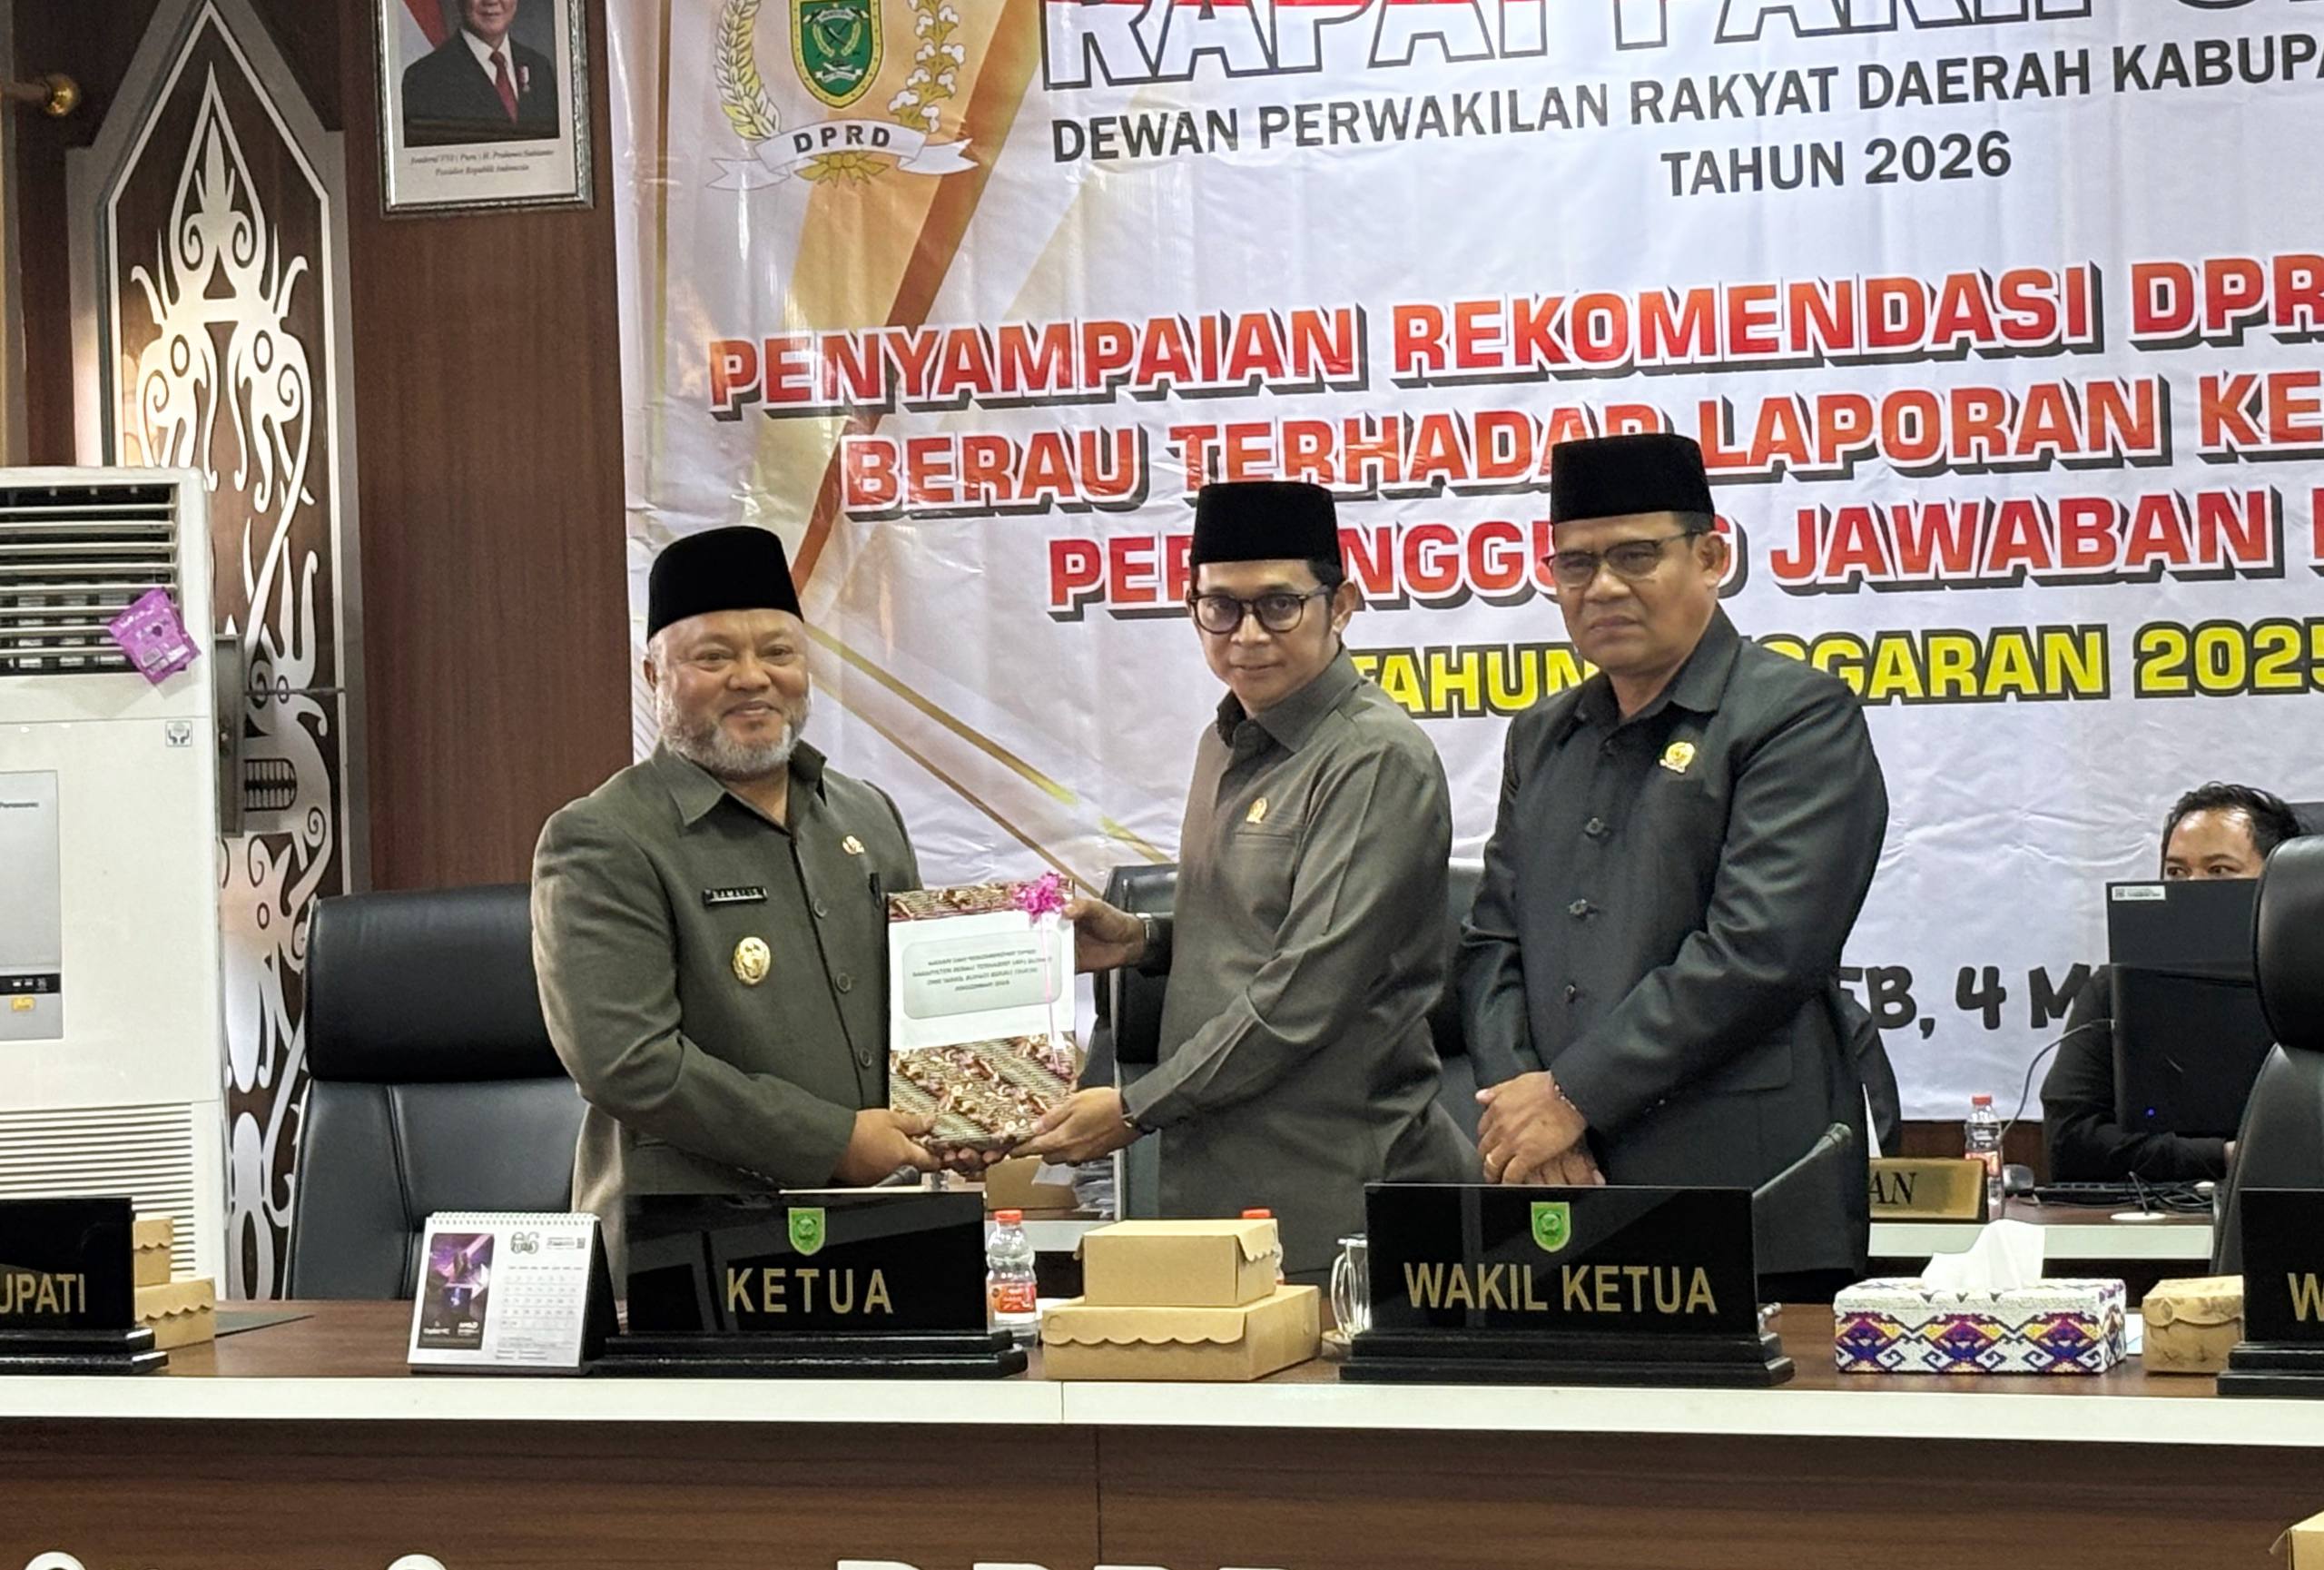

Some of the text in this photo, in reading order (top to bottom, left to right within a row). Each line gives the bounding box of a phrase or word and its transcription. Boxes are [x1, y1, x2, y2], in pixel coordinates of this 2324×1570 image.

[1052, 33, 2324, 163] DEWAN PERWAKILAN RAKYAT DAERAH KABUP
[793, 124, 891, 153] DPRD
[1660, 131, 2012, 196] TAHUN 2026
[710, 303, 1368, 421] PENYAMPAIAN
[1392, 262, 2105, 389] REKOMENDASI
[841, 424, 1148, 521] BERAU
[1699, 374, 2172, 484] LAPORAN
[1770, 484, 2285, 596] JAWABAN
[2135, 617, 2324, 698] 202
[1955, 965, 2007, 1030] 4
[727, 1268, 893, 1314] KETUA
[1404, 1262, 1717, 1314] WAKIL KETUA
